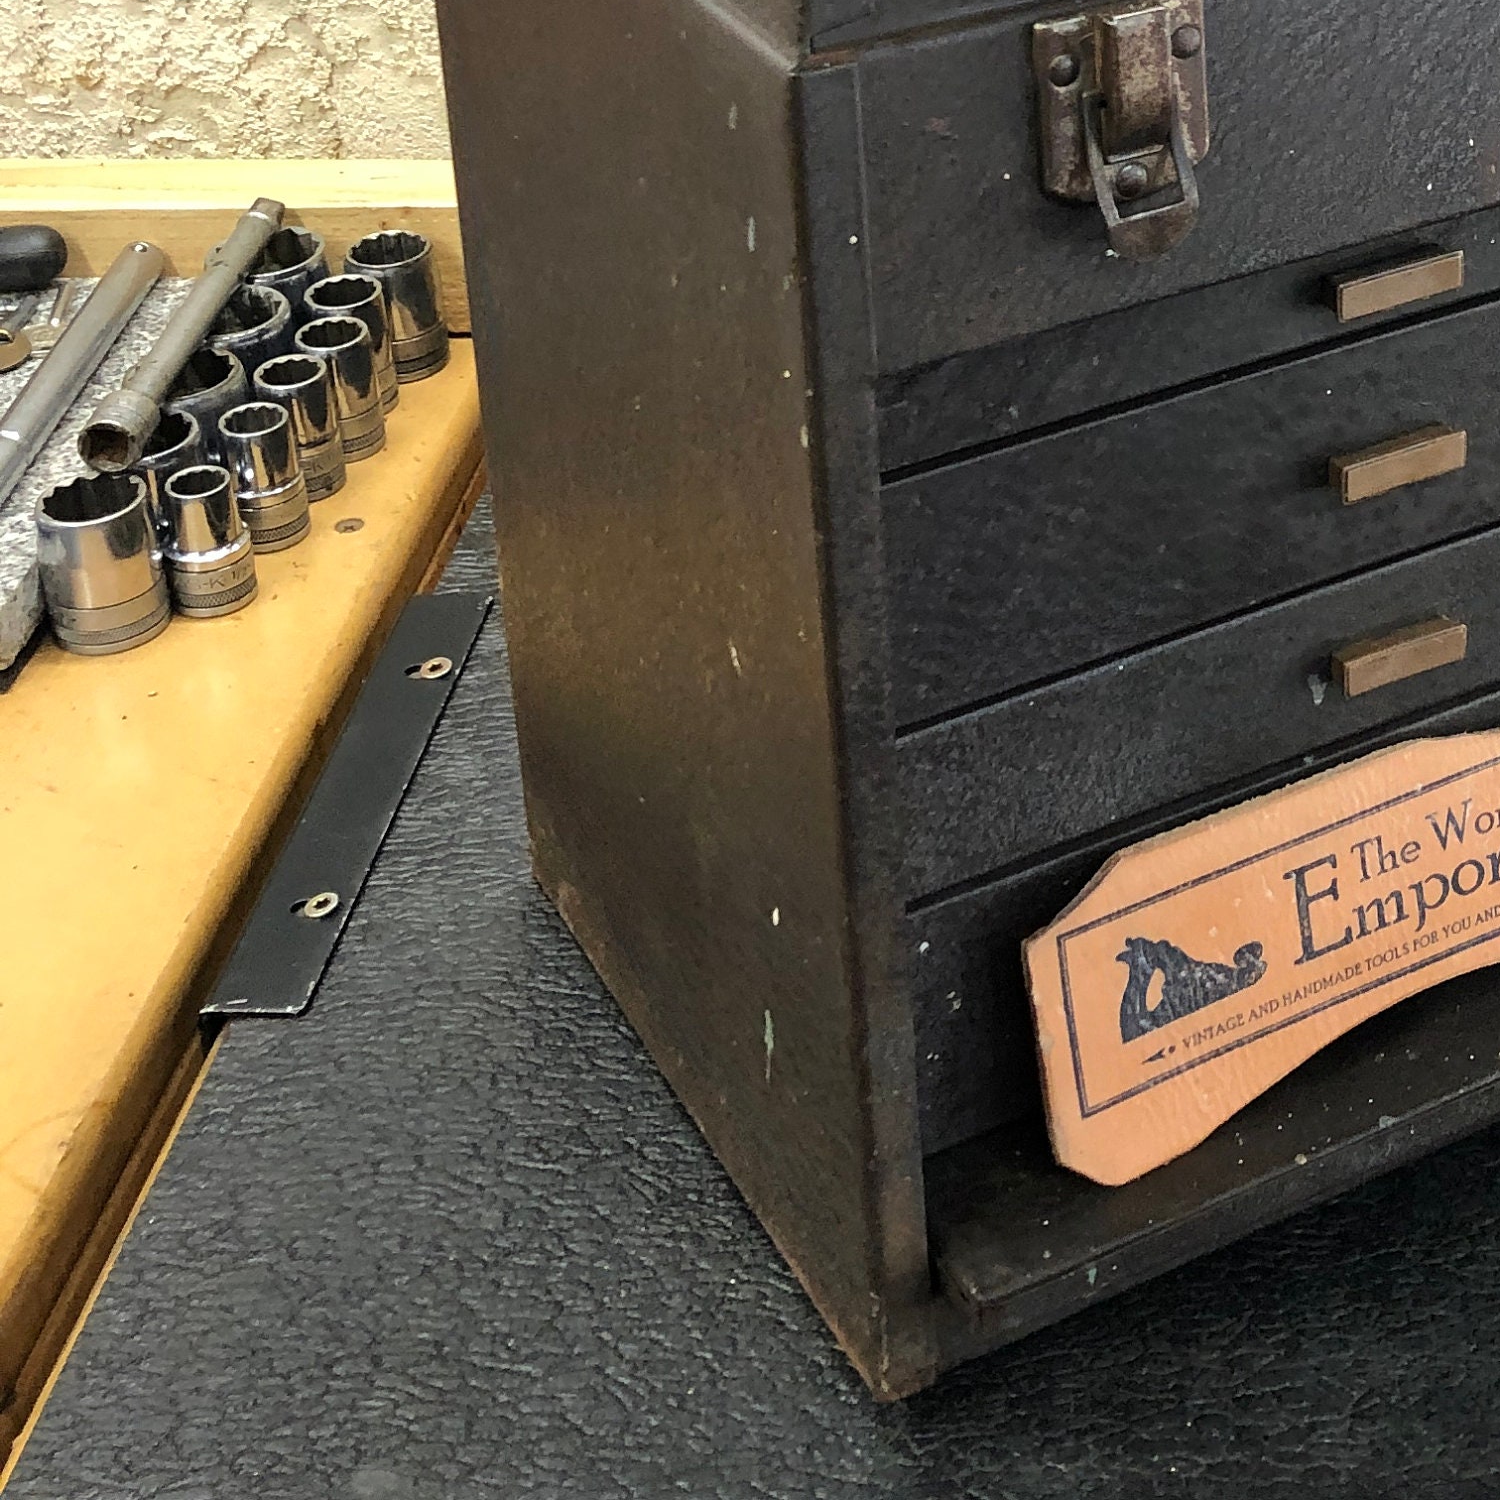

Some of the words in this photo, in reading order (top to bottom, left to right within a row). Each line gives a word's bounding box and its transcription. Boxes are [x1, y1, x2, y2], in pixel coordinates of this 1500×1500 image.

[1351, 835, 1421, 884] The
[1181, 1012, 1245, 1049] VINTAGE
[1248, 998, 1280, 1023] AND
[1282, 960, 1363, 1008] HANDMADE
[1365, 943, 1411, 971] TOOLS
[1412, 930, 1439, 952] FOR
[1442, 917, 1472, 939] YOU
